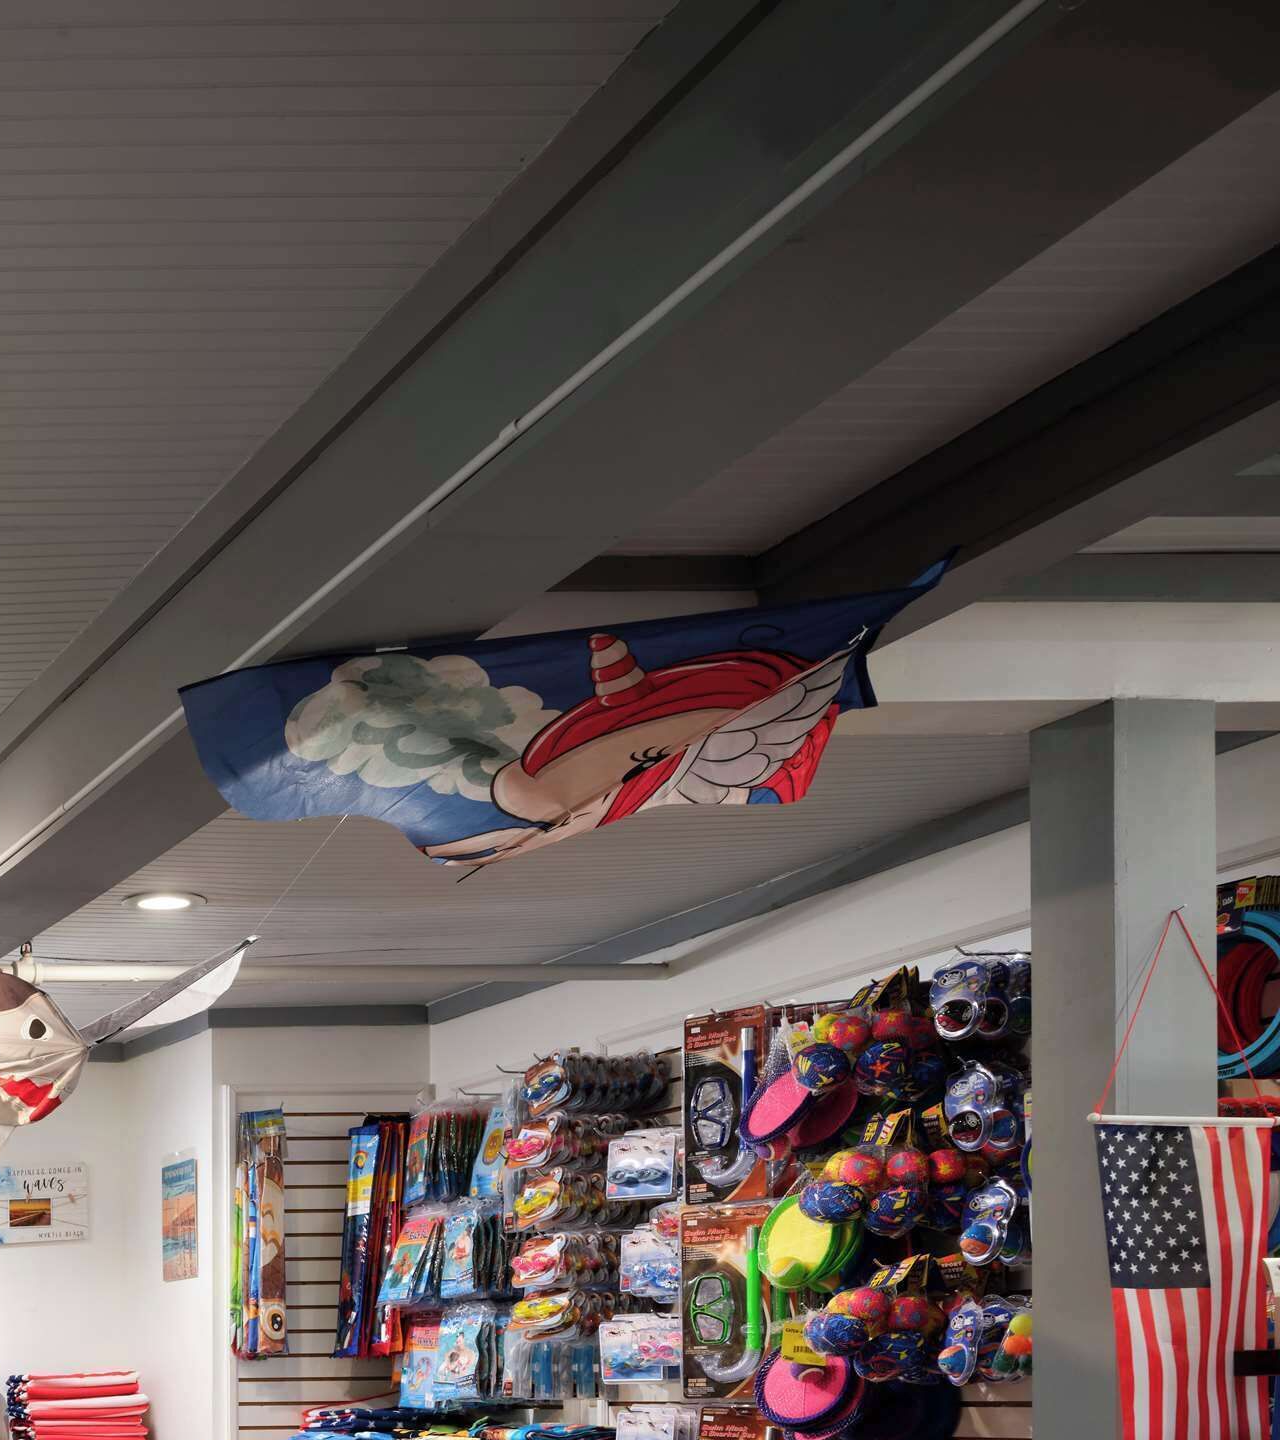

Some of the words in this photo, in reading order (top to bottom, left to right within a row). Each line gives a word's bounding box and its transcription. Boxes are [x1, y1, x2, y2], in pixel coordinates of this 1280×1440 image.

[7, 1167, 46, 1177] HAPPINESS
[48, 1166, 71, 1175] COMES
[23, 1177, 64, 1194] waves
